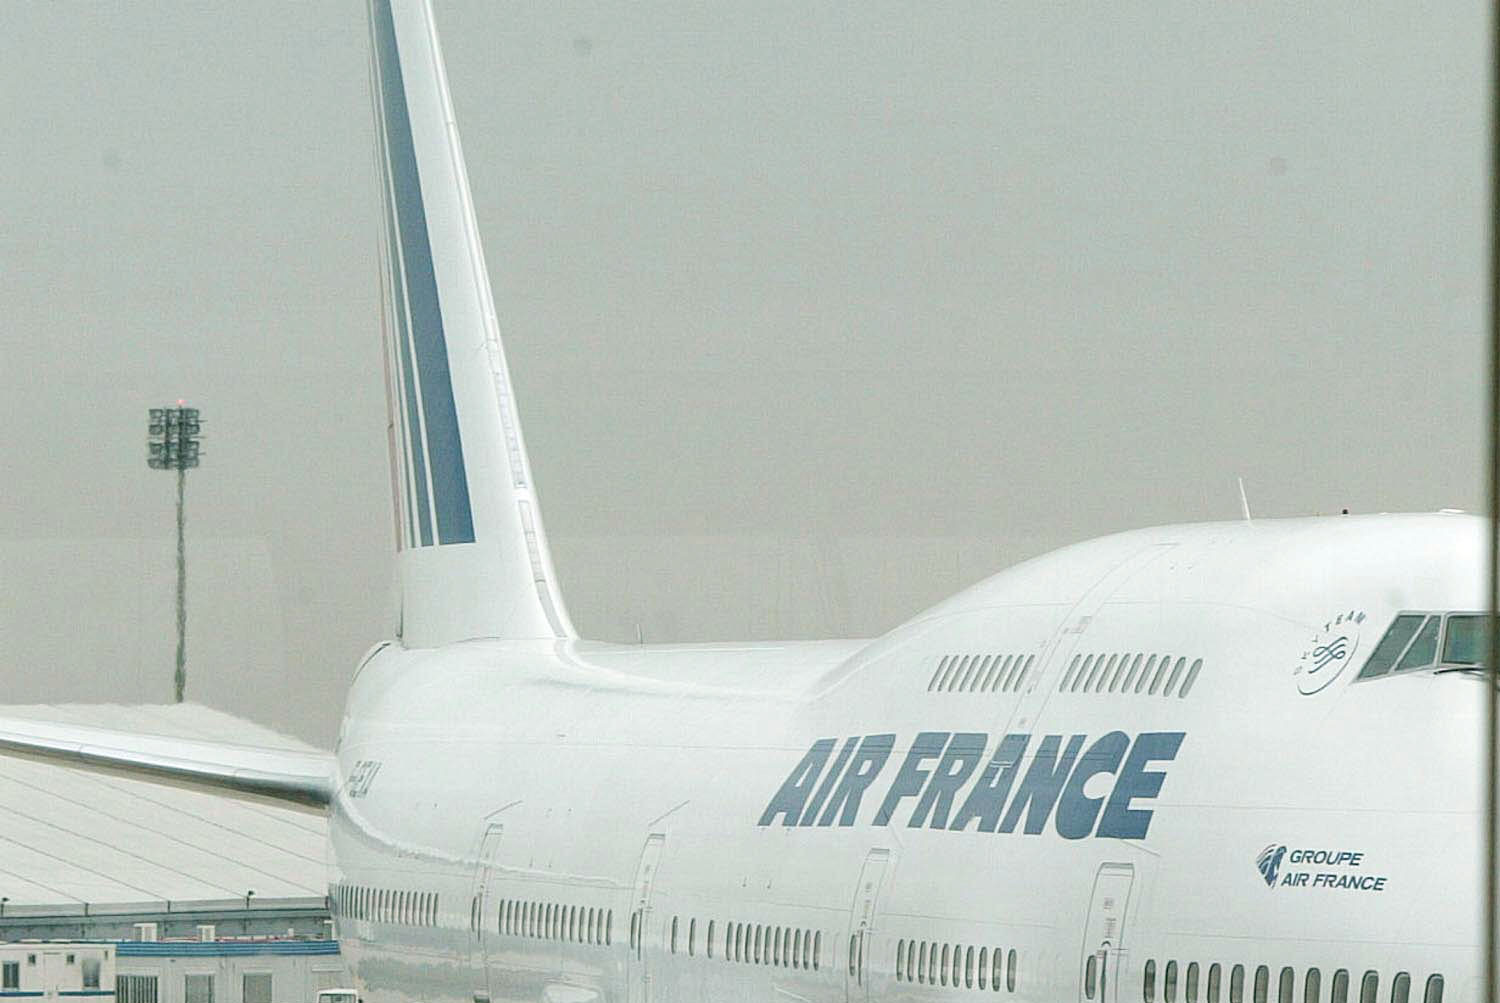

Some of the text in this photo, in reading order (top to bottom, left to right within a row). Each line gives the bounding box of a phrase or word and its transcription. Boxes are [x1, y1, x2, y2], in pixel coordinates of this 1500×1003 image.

[757, 730, 1186, 840] AIR FRANCE
[1289, 849, 1364, 866] GROUPE
[1281, 873, 1388, 891] AIR FRANCE
